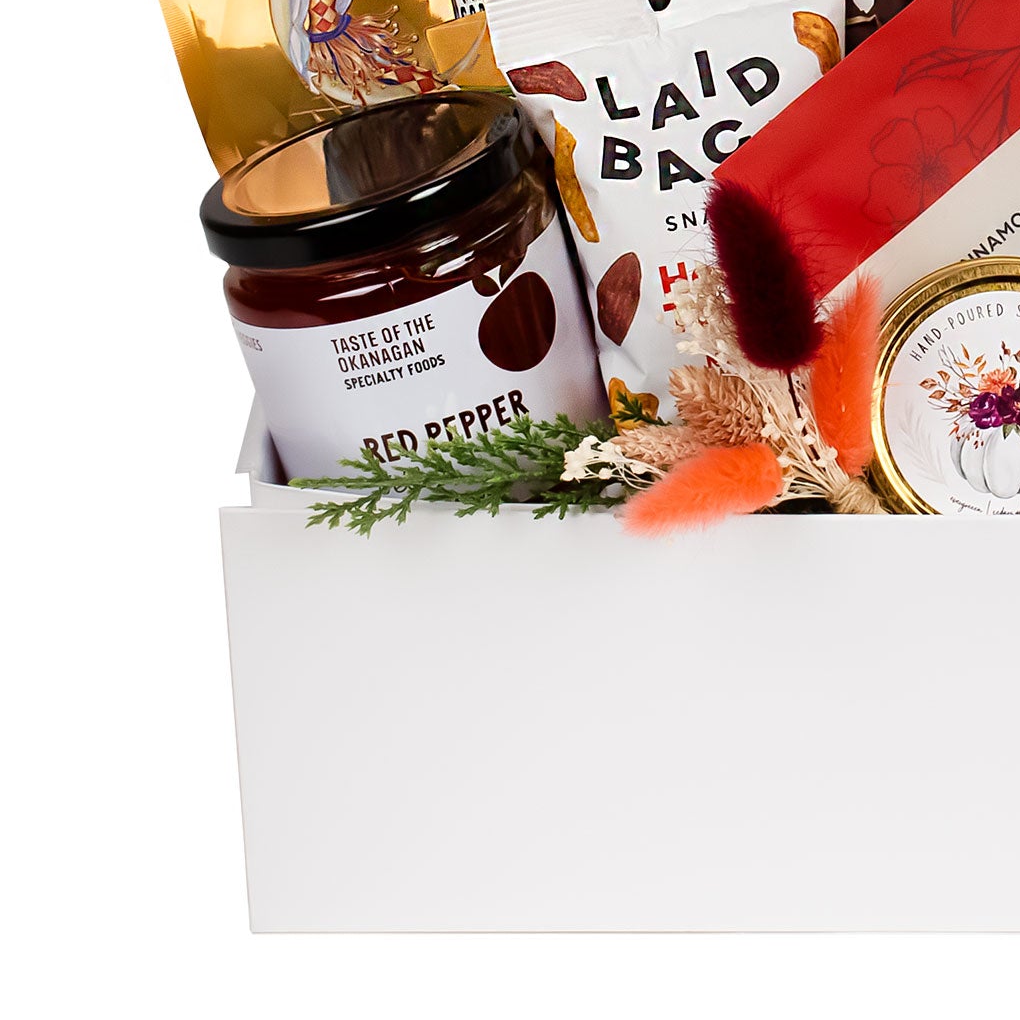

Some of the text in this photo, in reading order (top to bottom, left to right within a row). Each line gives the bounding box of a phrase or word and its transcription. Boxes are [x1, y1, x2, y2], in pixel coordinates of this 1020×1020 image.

[595, 49, 780, 130] LAID
[331, 313, 436, 355] TASTE OF THE
[337, 337, 426, 373] OKANAGAN
[344, 353, 446, 390] SPECIALTY FOODS
[362, 429, 419, 464] RED
